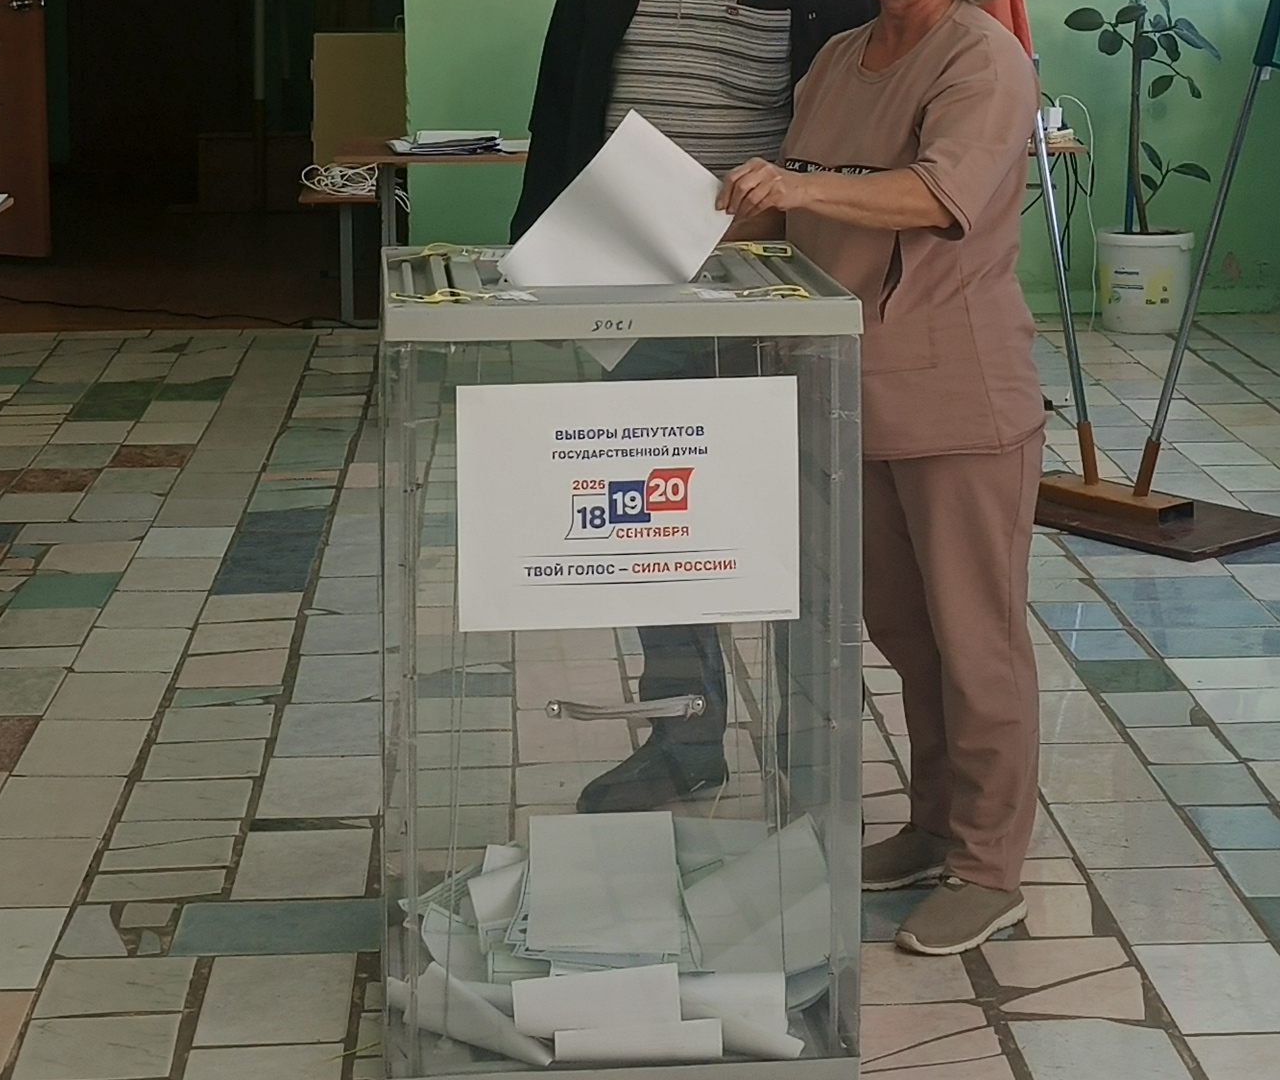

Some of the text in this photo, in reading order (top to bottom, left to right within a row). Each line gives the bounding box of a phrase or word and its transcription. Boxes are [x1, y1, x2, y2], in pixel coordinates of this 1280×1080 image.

[555, 425, 705, 440] ВЫБОРЫ ДЕПУТАТОВ
[552, 445, 708, 460] ГОСУДАРСТВЕННОЙ ДУМЫ
[577, 478, 684, 529] 18 19 20
[616, 526, 689, 539] СЕНТЯБРЯ
[524, 563, 564, 577] ТВОЙ
[568, 564, 615, 576] ГОЛОС
[632, 563, 670, 574] СИЛА
[675, 560, 737, 572] РОССИИ!
